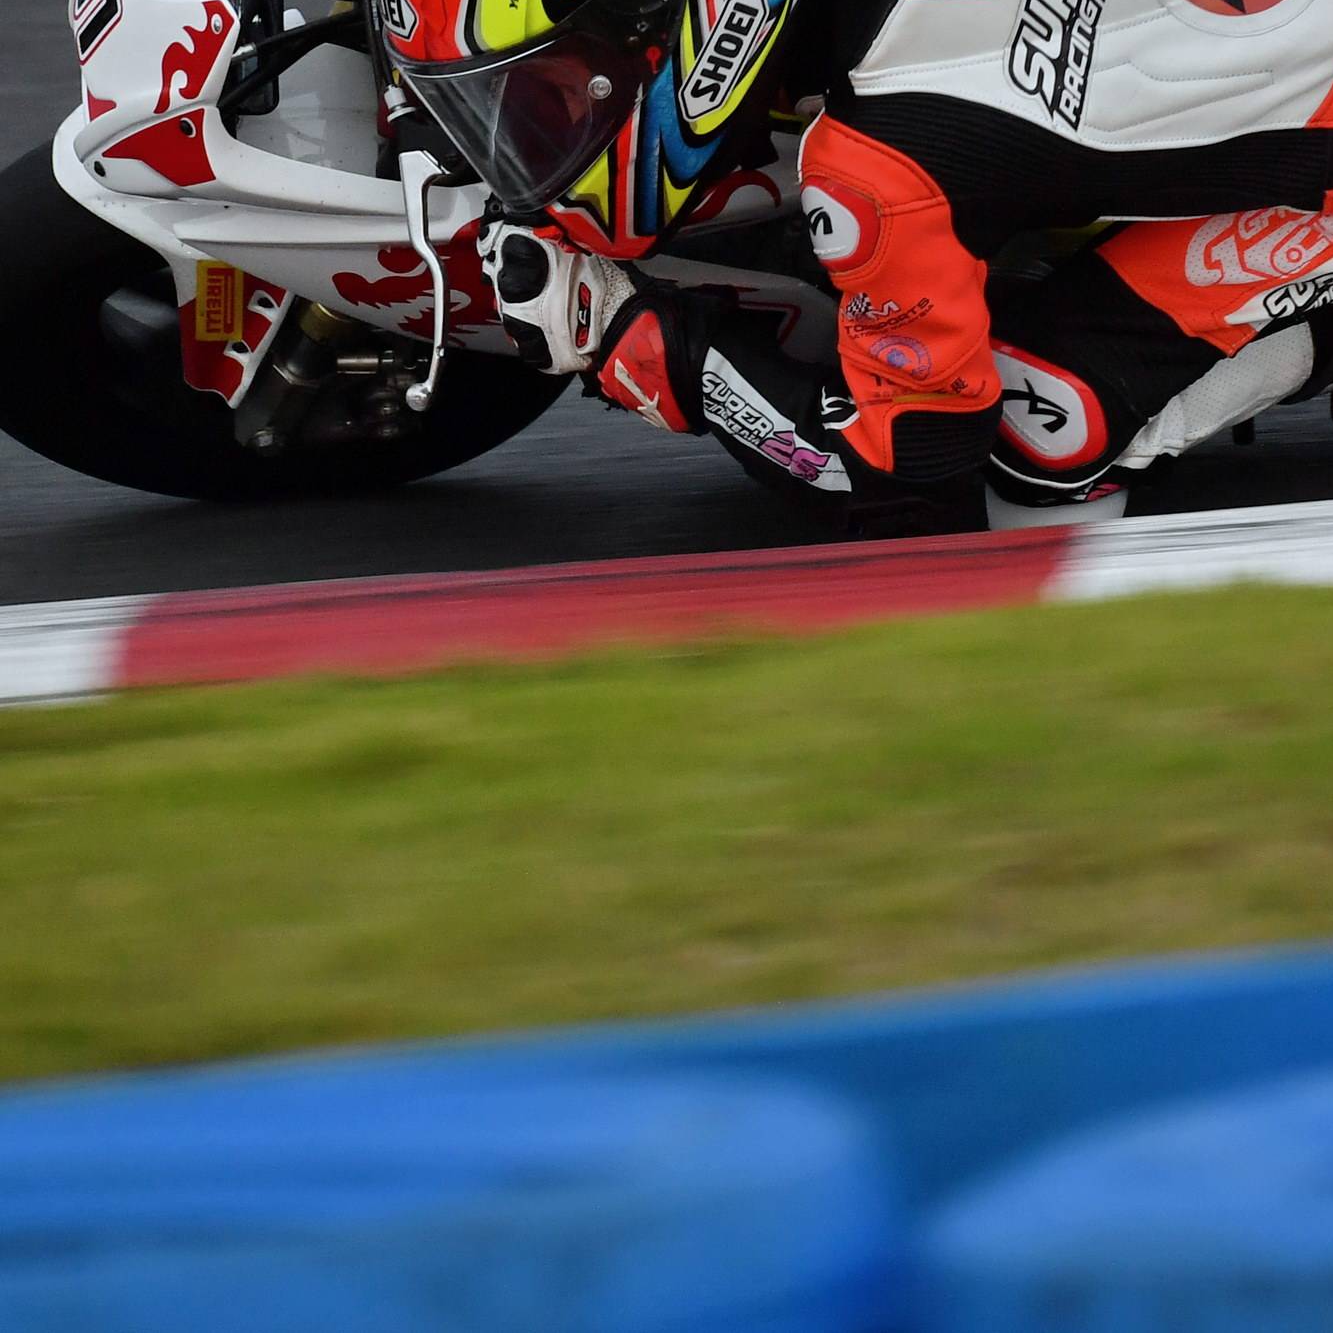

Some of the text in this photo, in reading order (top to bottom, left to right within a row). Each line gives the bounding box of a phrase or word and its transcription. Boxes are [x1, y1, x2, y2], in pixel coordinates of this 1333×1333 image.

[690, 1, 760, 104] SHOEI
[206, 267, 235, 335] PIRELLI
[701, 371, 775, 440] SUPER
